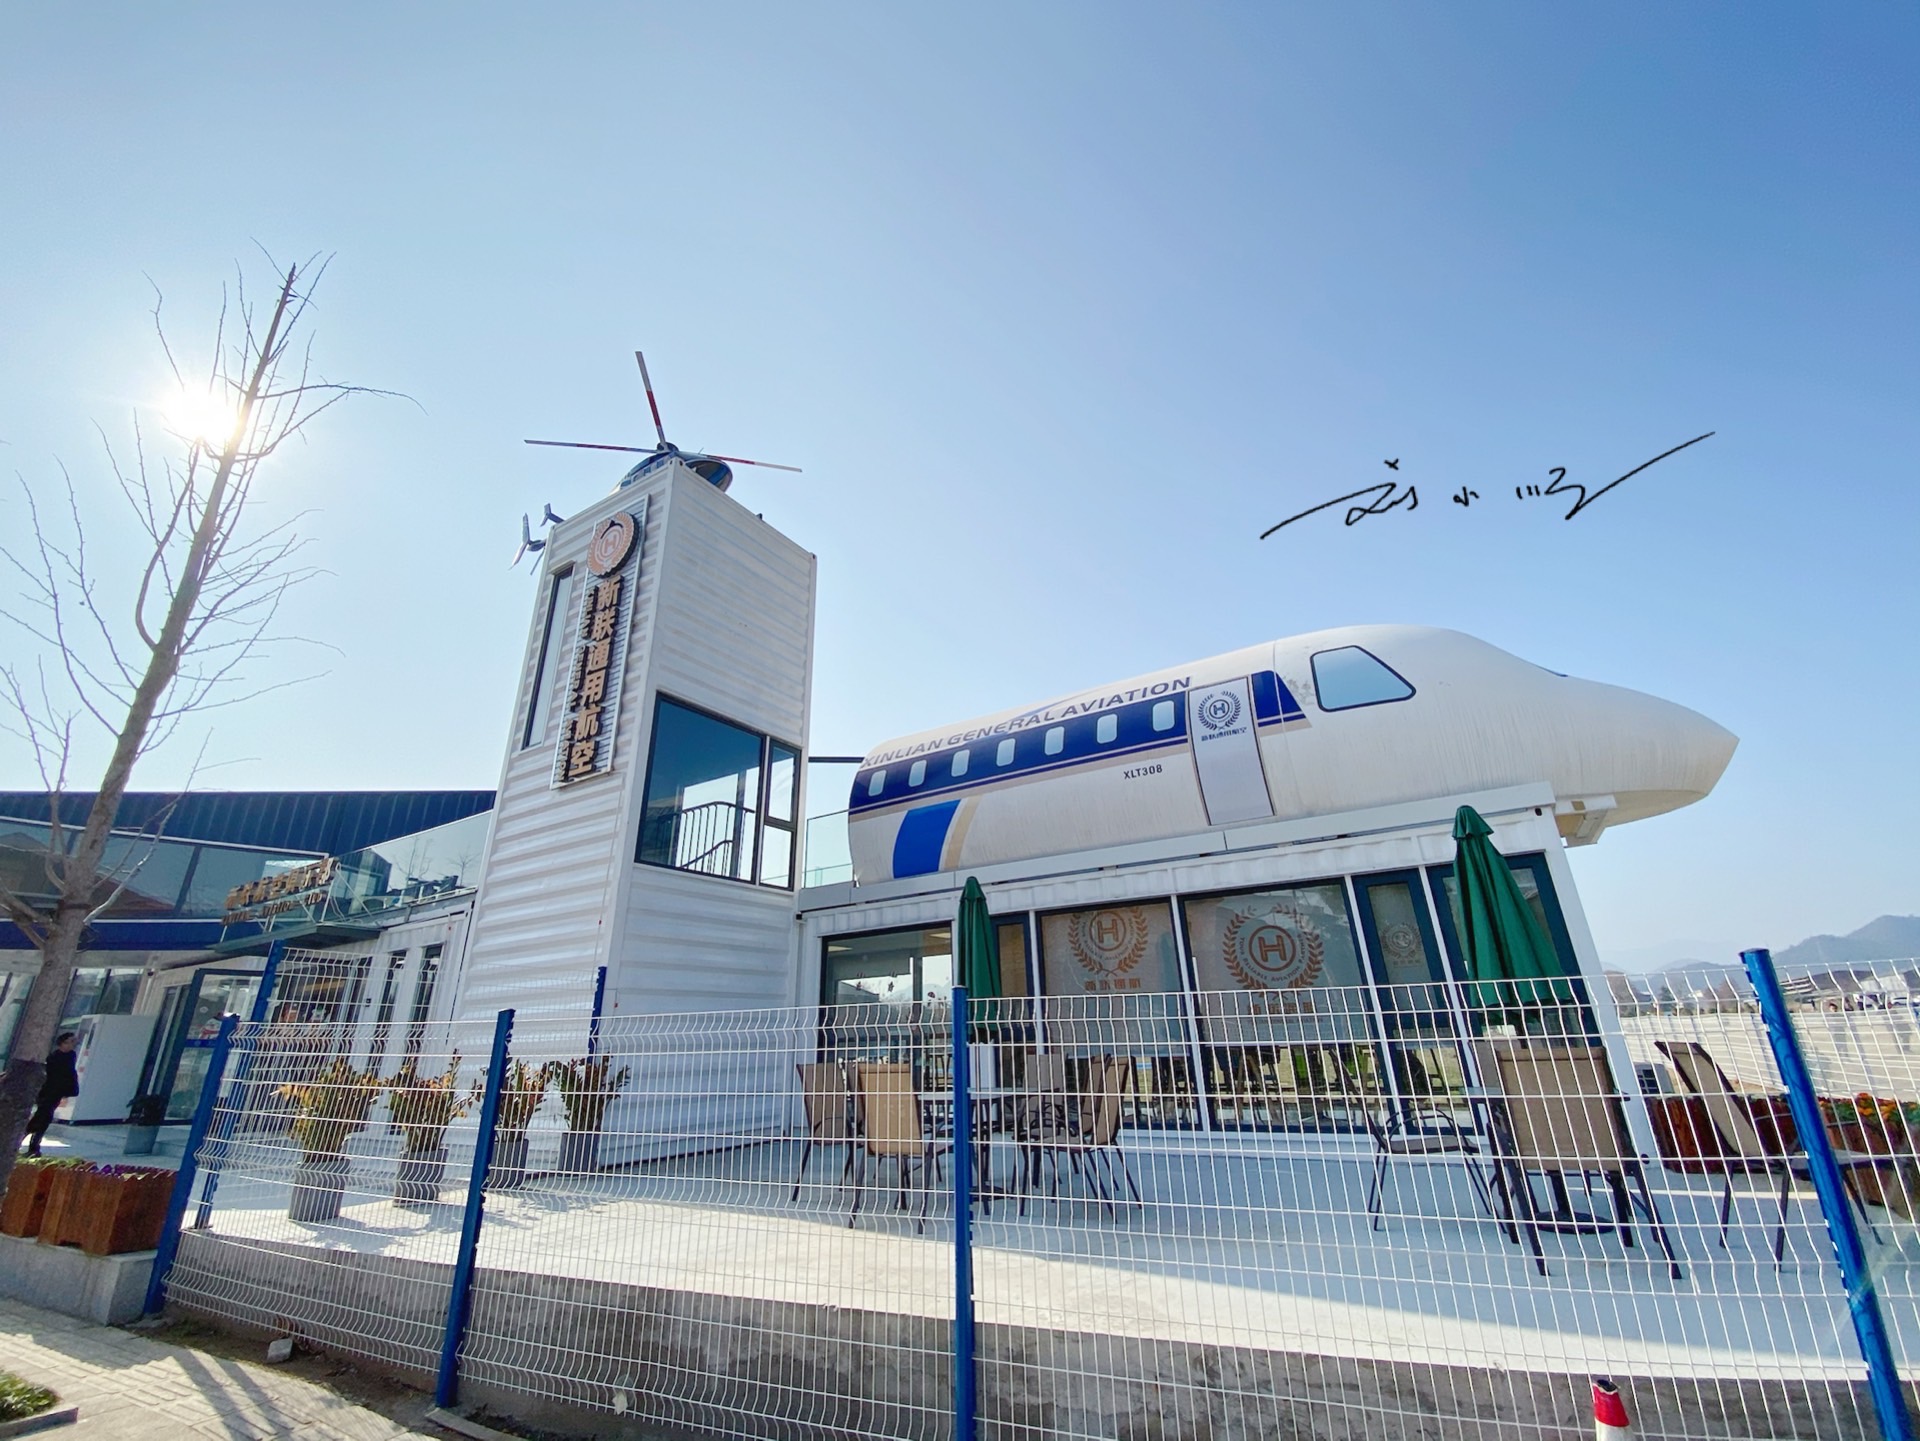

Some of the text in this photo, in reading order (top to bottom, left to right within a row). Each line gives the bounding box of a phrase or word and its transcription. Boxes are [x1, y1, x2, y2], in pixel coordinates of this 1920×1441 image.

[571, 576, 621, 776] 新联通用航空
[861, 675, 1192, 768] XINLIAN GENERAL AVIATION
[1123, 763, 1164, 780] XLT308
[1258, 934, 1287, 963] H
[1270, 965, 1301, 983] AVIATION
